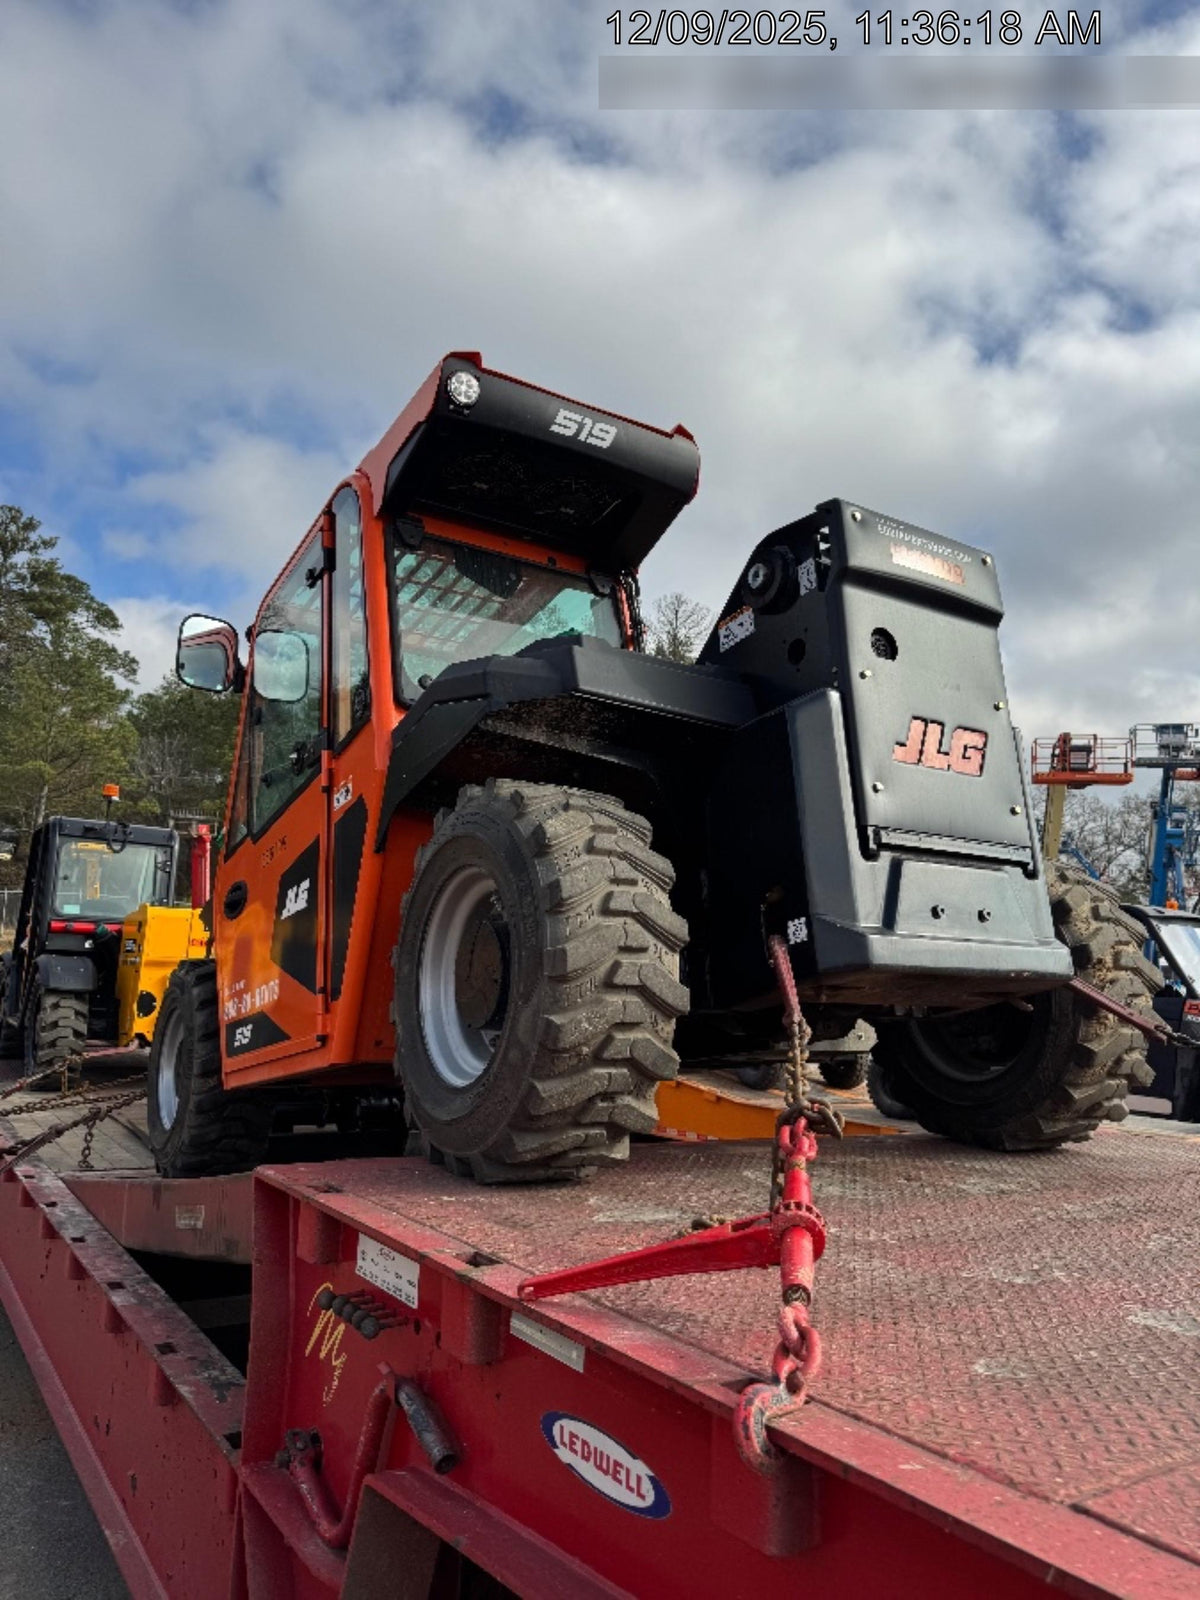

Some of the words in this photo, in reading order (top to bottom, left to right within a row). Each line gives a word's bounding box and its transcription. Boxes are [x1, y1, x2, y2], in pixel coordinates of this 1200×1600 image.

[550, 408, 618, 449] 519
[892, 716, 988, 777] JLG
[559, 1423, 646, 1502] LEDWELL
